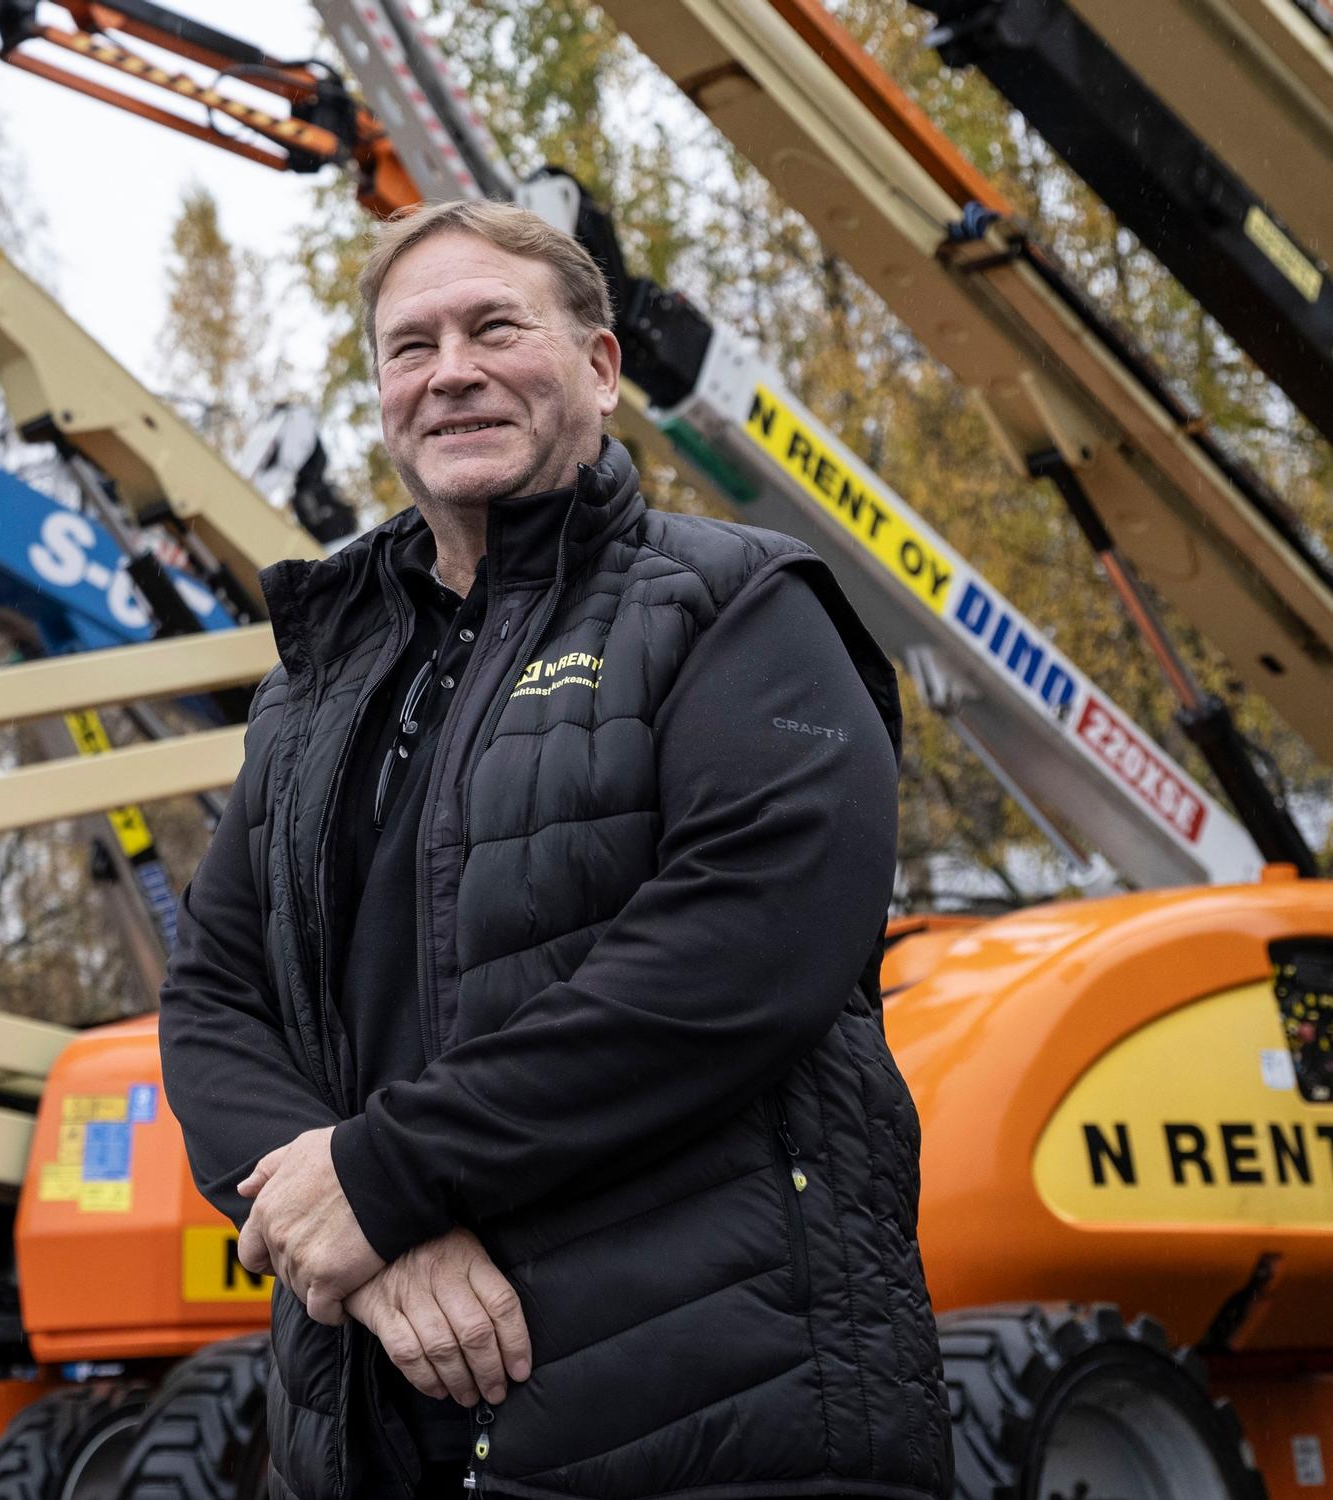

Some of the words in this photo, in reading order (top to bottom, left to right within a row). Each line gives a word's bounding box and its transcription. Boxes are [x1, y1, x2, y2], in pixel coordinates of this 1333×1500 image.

[748, 393, 776, 437] N
[786, 429, 892, 539] RENT
[899, 538, 951, 597] OY
[954, 580, 1077, 721] DINO
[544, 662, 558, 677] N
[772, 717, 835, 738] CRAFT
[1082, 1122, 1138, 1186] N
